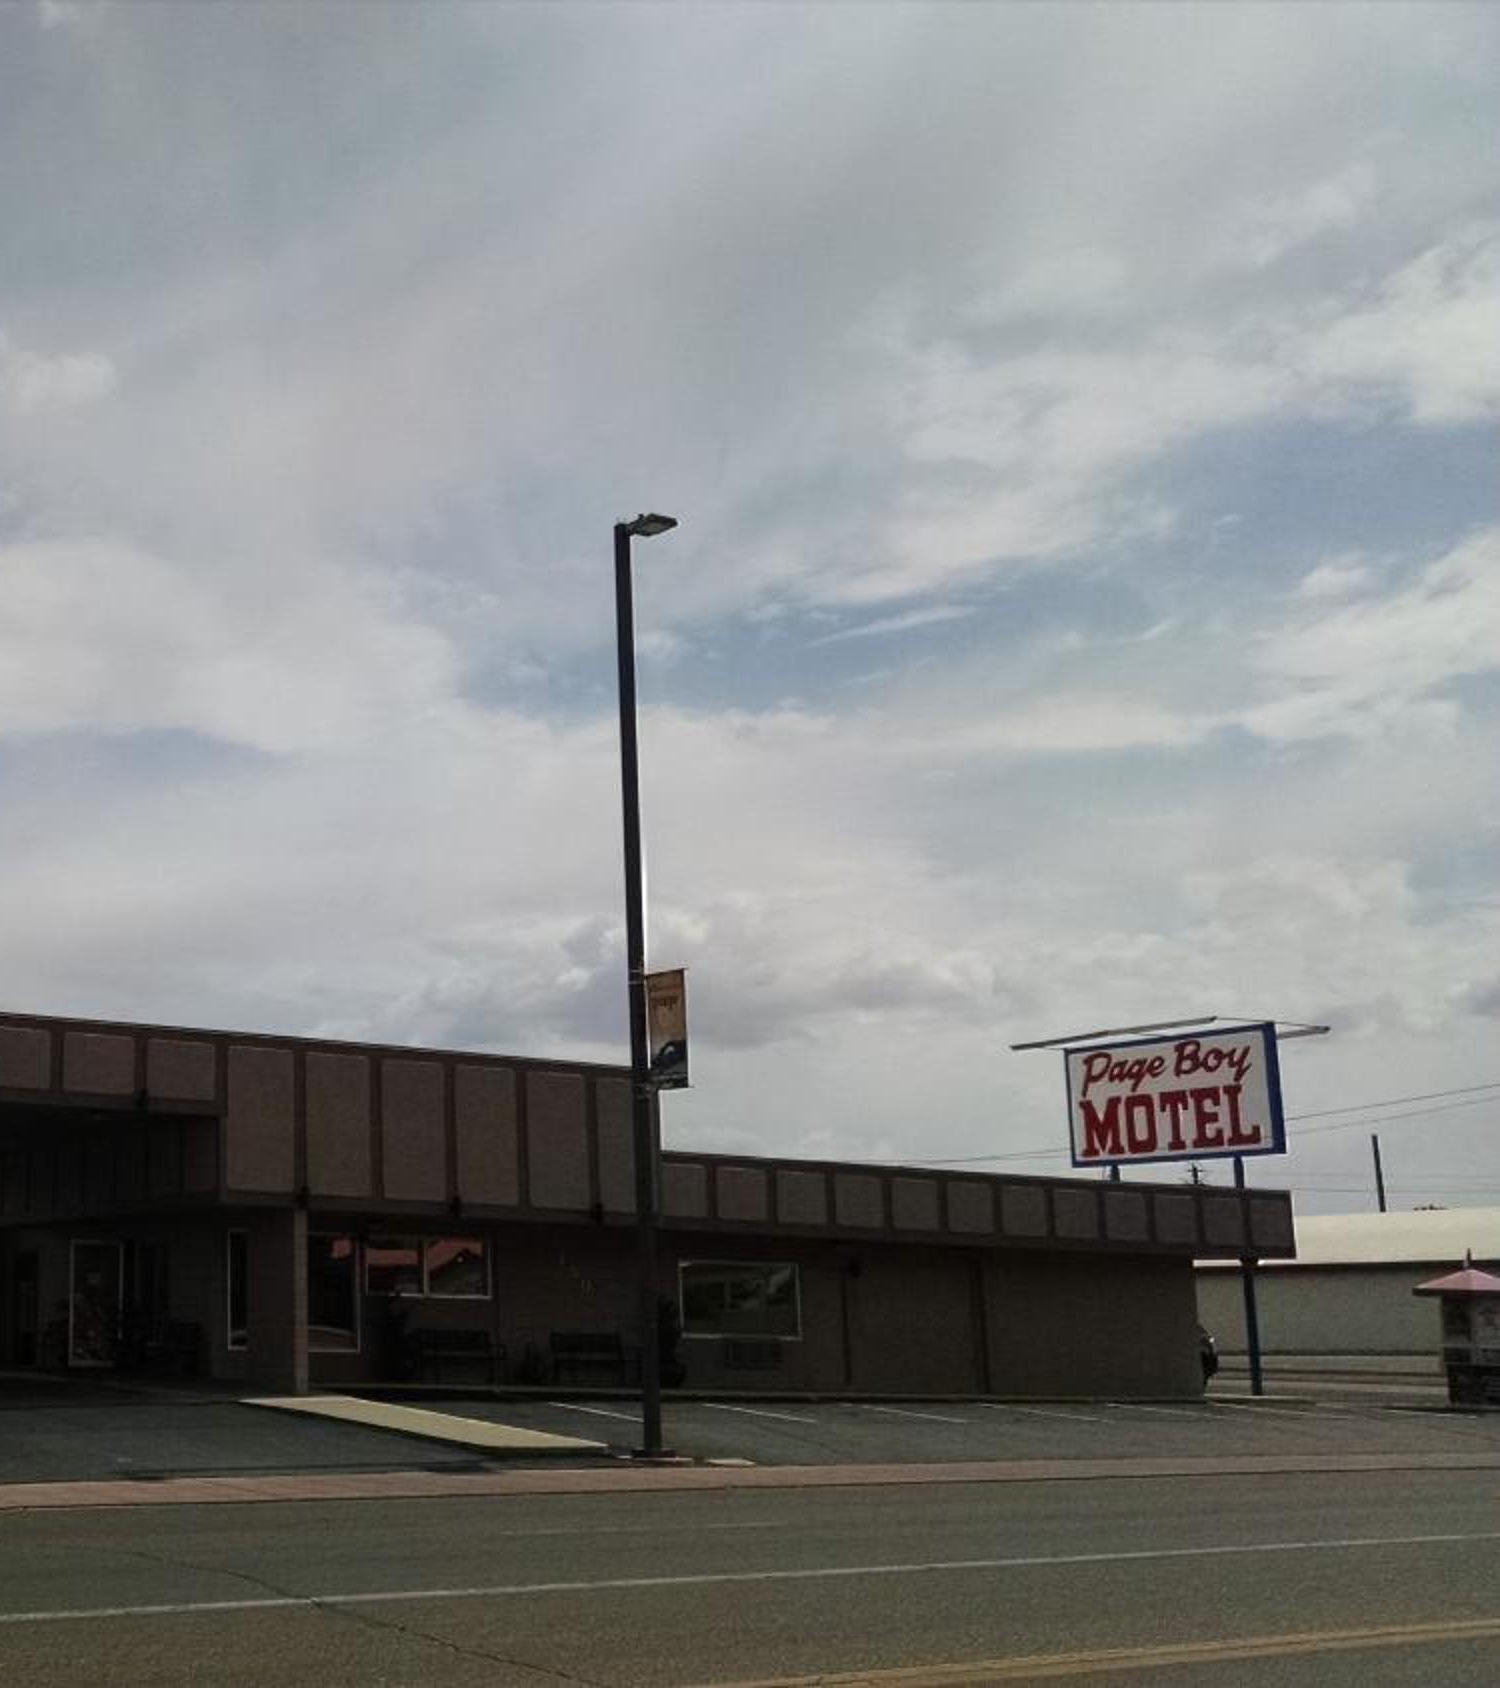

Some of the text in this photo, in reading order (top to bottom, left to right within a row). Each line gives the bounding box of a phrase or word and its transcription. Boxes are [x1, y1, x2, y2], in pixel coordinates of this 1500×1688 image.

[1080, 1039, 1253, 1097] Page Boy
[1079, 1084, 1262, 1158] MOTEL
